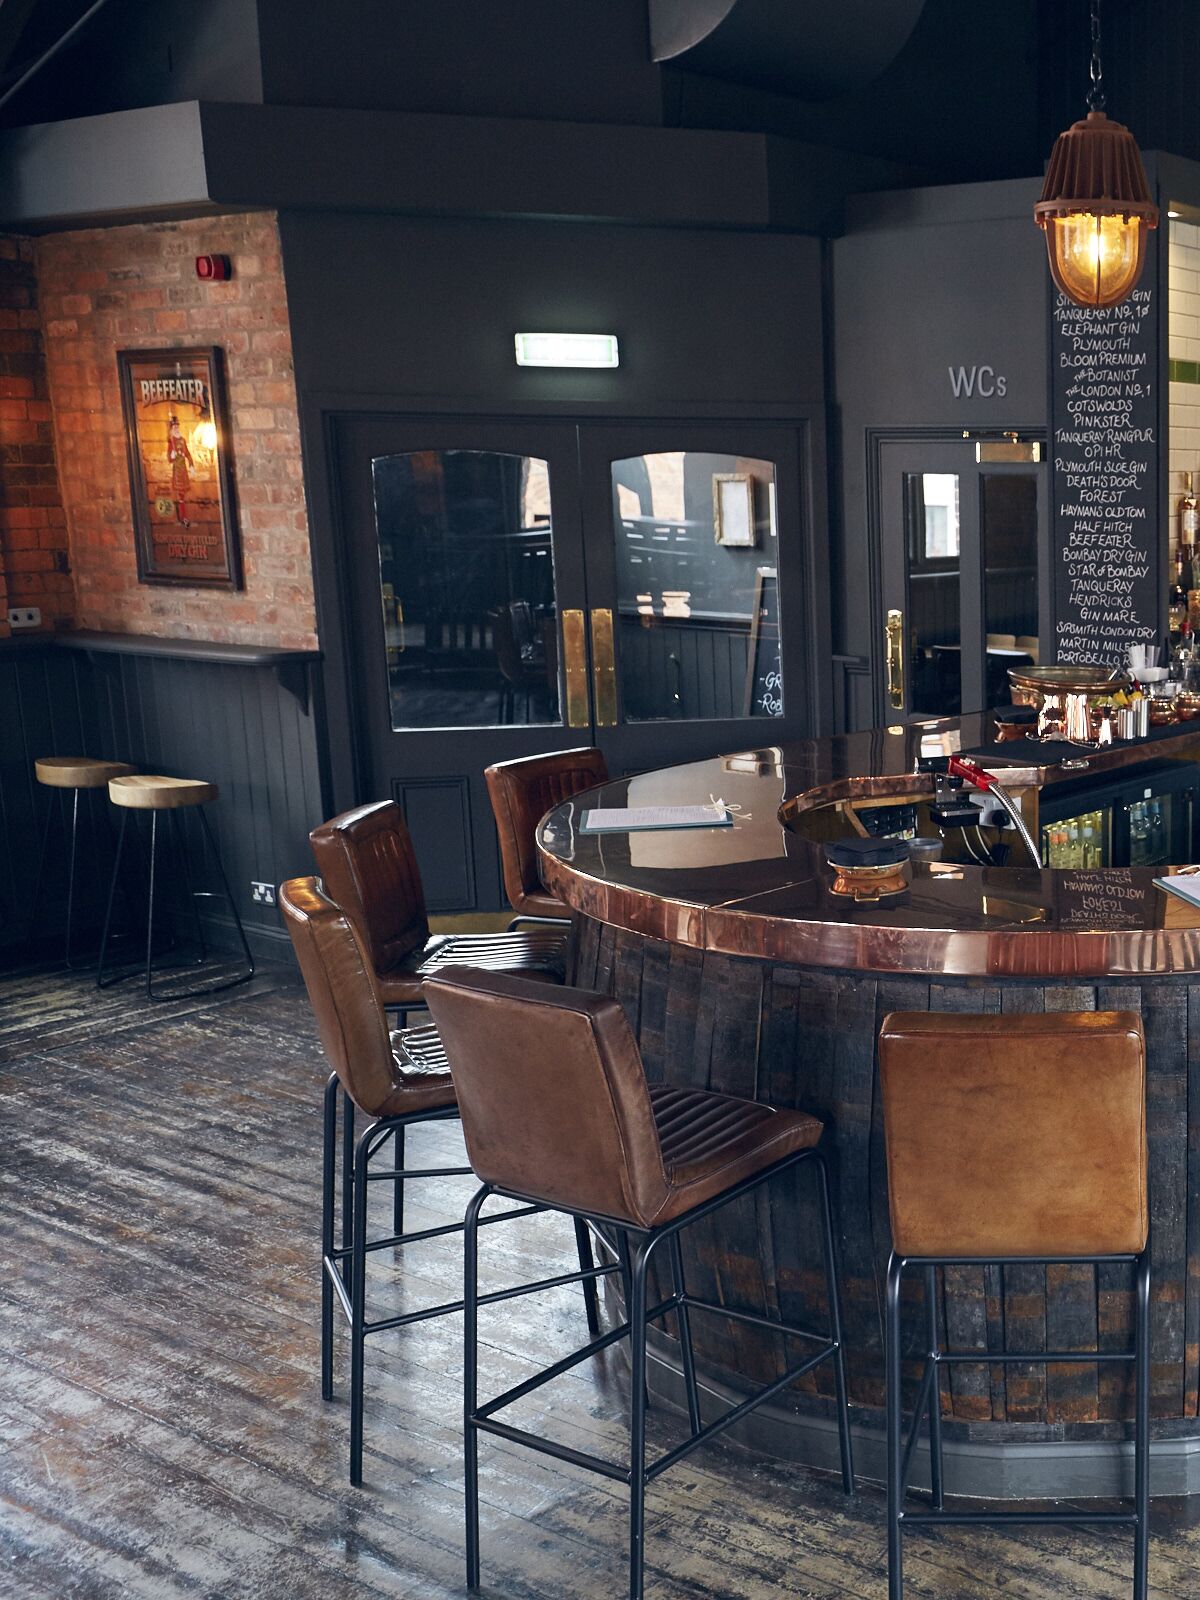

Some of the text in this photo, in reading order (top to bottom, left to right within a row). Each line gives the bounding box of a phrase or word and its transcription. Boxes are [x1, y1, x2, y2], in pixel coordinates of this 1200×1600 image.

[1132, 290, 1152, 302] GIN
[1054, 307, 1112, 322] TANQUERAY
[1062, 322, 1140, 336] ELEPHANT GIN
[1073, 337, 1130, 350] PLYMOUTH
[1060, 352, 1146, 367] BLOOM PREMIUM
[948, 366, 1006, 397] WCs
[1074, 368, 1139, 382] THE BOTANIST
[140, 379, 206, 407] BEEFEATER
[1066, 385, 1080, 397] THE
[1080, 385, 1121, 396] LONDON
[1067, 400, 1133, 412] COTSWOLDS
[1073, 413, 1134, 428] PINKSTER
[1055, 428, 1155, 446] TANQUERAY RANGPUR
[1054, 458, 1147, 474] PLYMOUTH SLOE GIN
[1067, 474, 1142, 490] DEATH'S DOOR
[1079, 489, 1126, 503] FOREST
[1061, 504, 1146, 518] HAYMANS OLD TOM
[1074, 521, 1132, 532] HALF HITCH
[1069, 533, 1136, 548] BEEFEATER
[1063, 548, 1147, 563] BOMBAY DRY GIN
[1068, 563, 1098, 577] STAR
[1107, 565, 1149, 578] BOMBAY
[1071, 579, 1134, 594] TANQUERAY
[1069, 593, 1132, 608] HENDRICKS
[1080, 608, 1140, 623] GIN MARE
[1056, 621, 1156, 638] SIPSMITH LONDON DRY
[1060, 637, 1099, 651] MARTIN
[1057, 650, 1120, 665] PORTOBELLO
